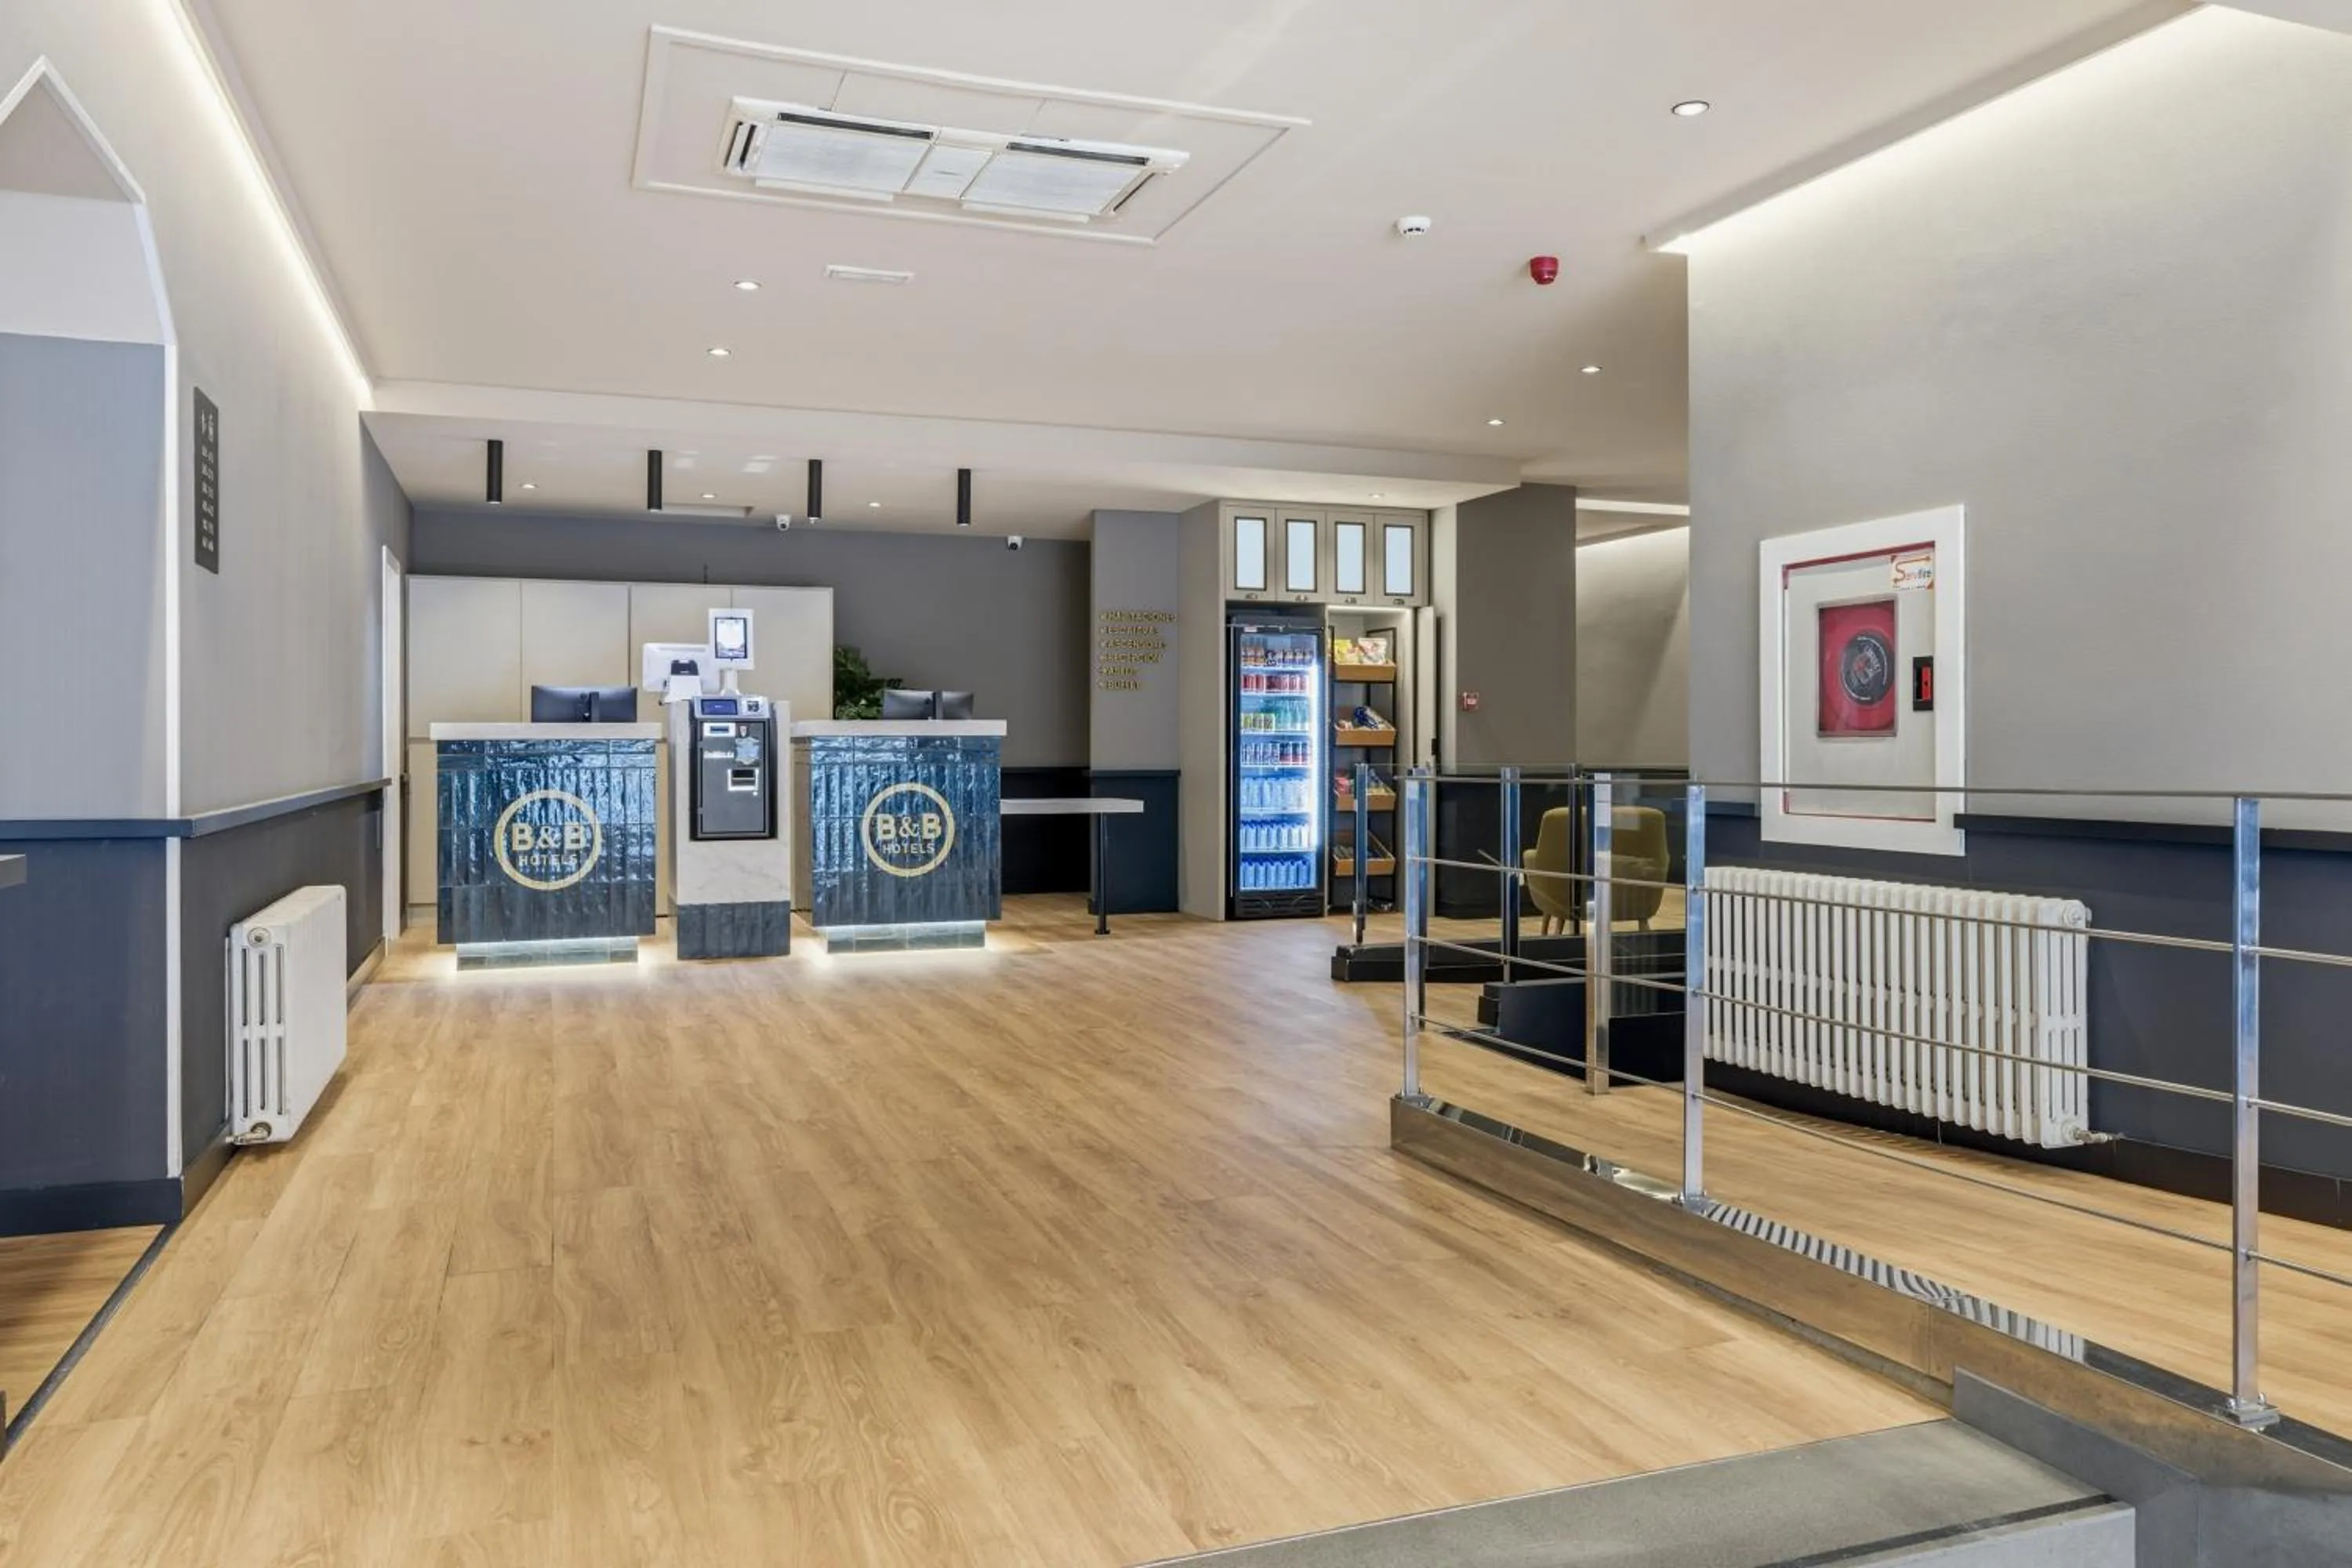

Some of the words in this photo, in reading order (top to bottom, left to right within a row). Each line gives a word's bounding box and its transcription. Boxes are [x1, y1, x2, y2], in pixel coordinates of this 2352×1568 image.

[877, 813, 942, 840] B&B
[512, 822, 587, 852] B&B
[883, 843, 935, 854] HOTELS
[518, 854, 579, 866] HOTELS
